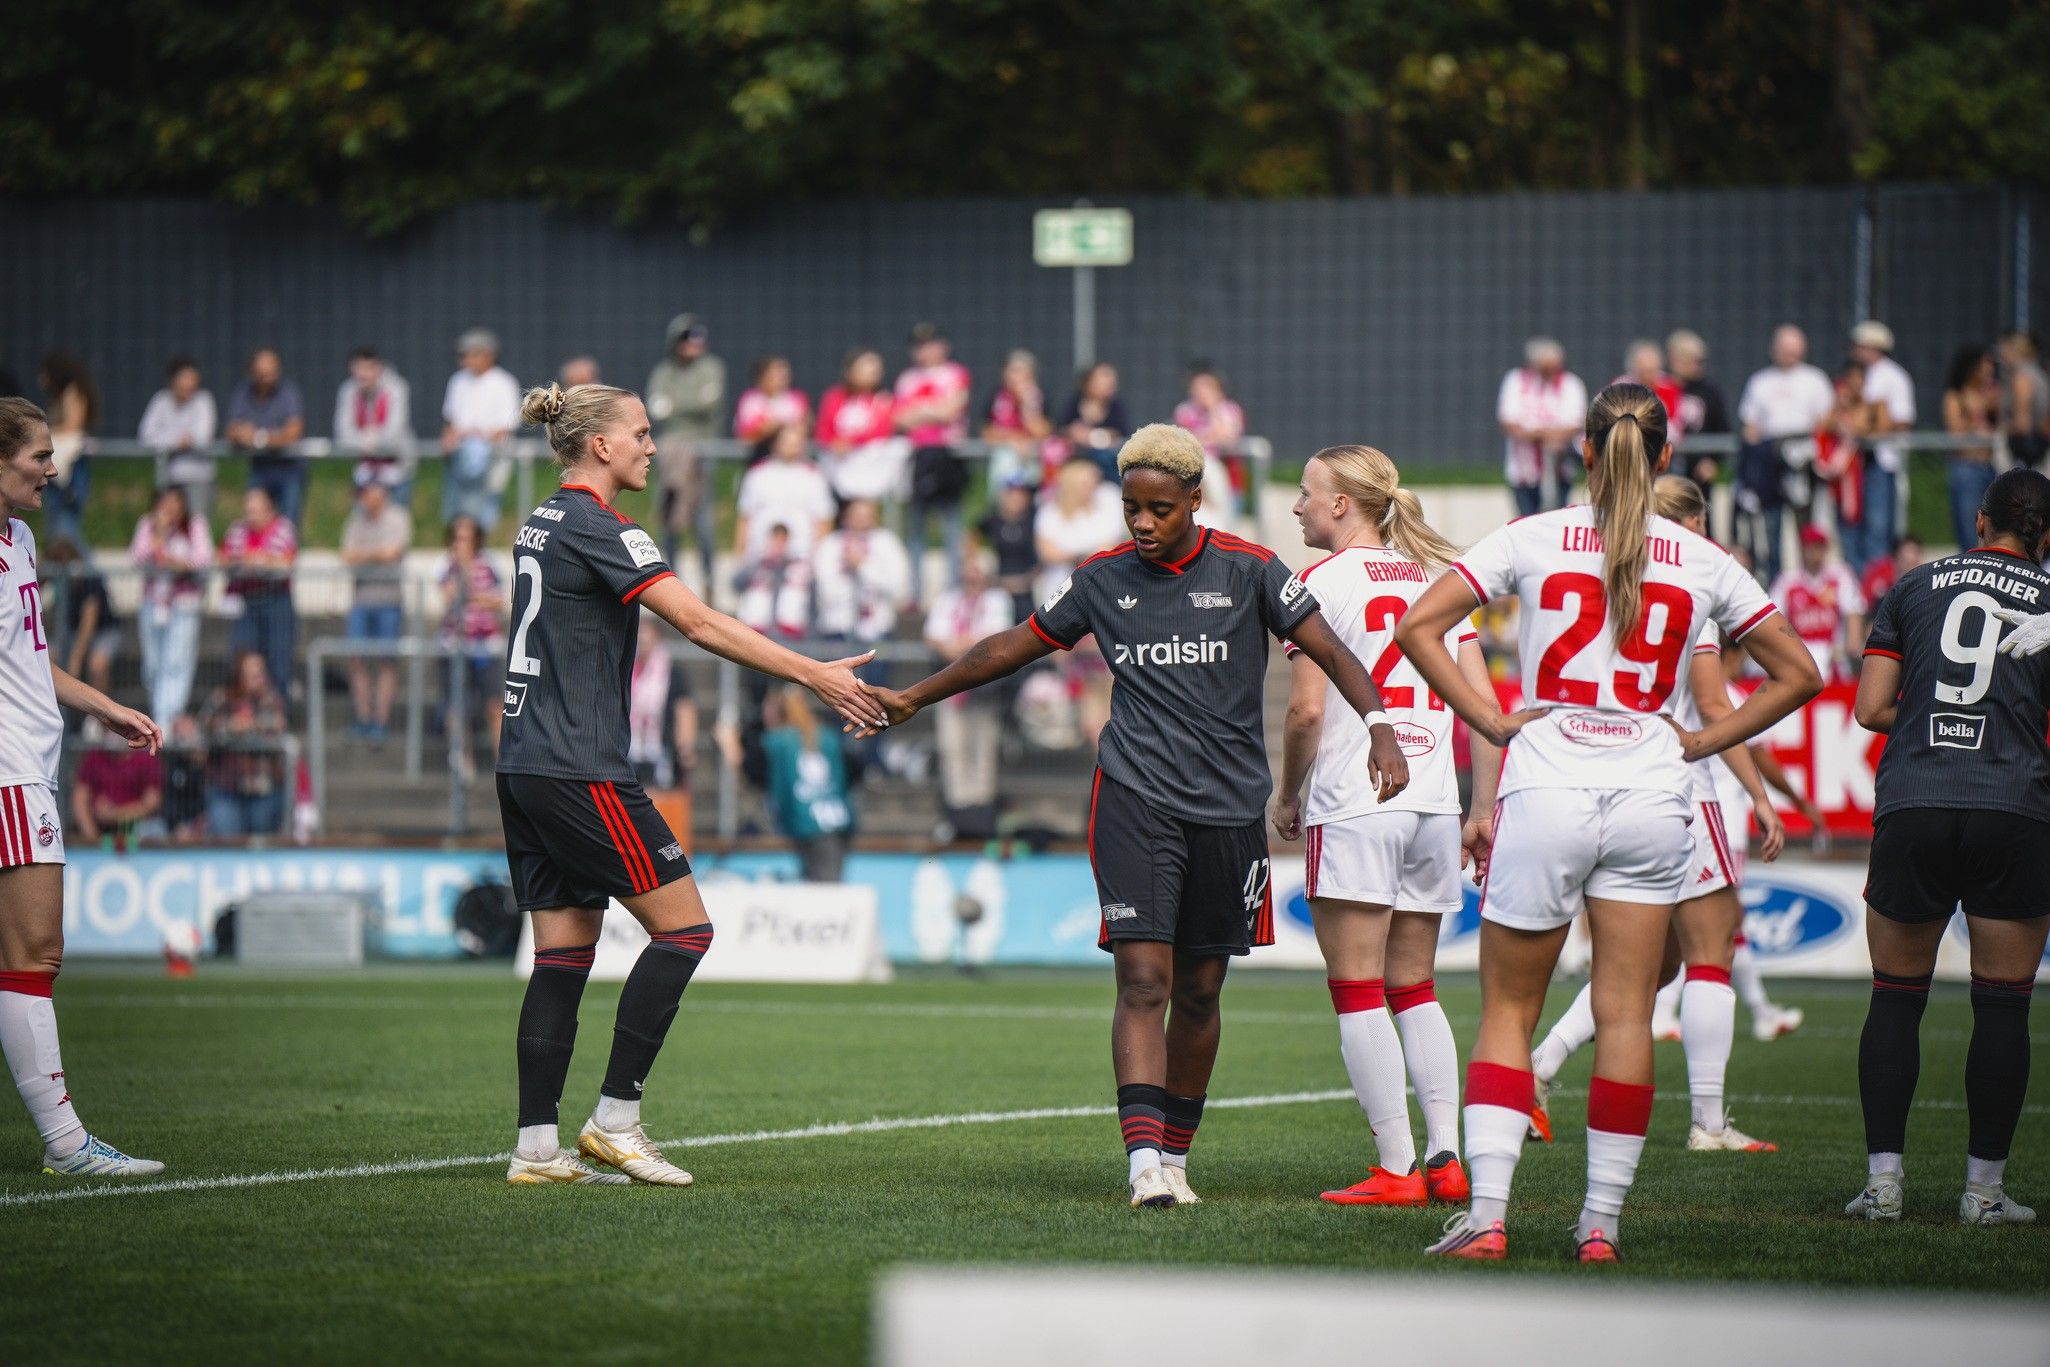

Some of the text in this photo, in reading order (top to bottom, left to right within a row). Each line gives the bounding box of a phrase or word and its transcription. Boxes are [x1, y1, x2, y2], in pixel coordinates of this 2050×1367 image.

[514, 525, 550, 551] SICKE
[1562, 526, 1682, 567] LEIMTOLL
[1931, 568, 2040, 605] WEIDAUER
[1944, 558, 1960, 566] FC
[1962, 558, 2003, 569] UNION
[2005, 564, 2050, 585] BERLIN
[508, 555, 541, 677] 2
[1137, 633, 1228, 666] raisin
[1364, 595, 1445, 712] 2
[1537, 571, 1694, 713] 29
[1934, 590, 2002, 706] 9
[1395, 729, 1429, 744] haebens
[1569, 720, 1632, 736] Schaebens
[1938, 722, 1975, 738] bella
[1243, 857, 1270, 911] 42
